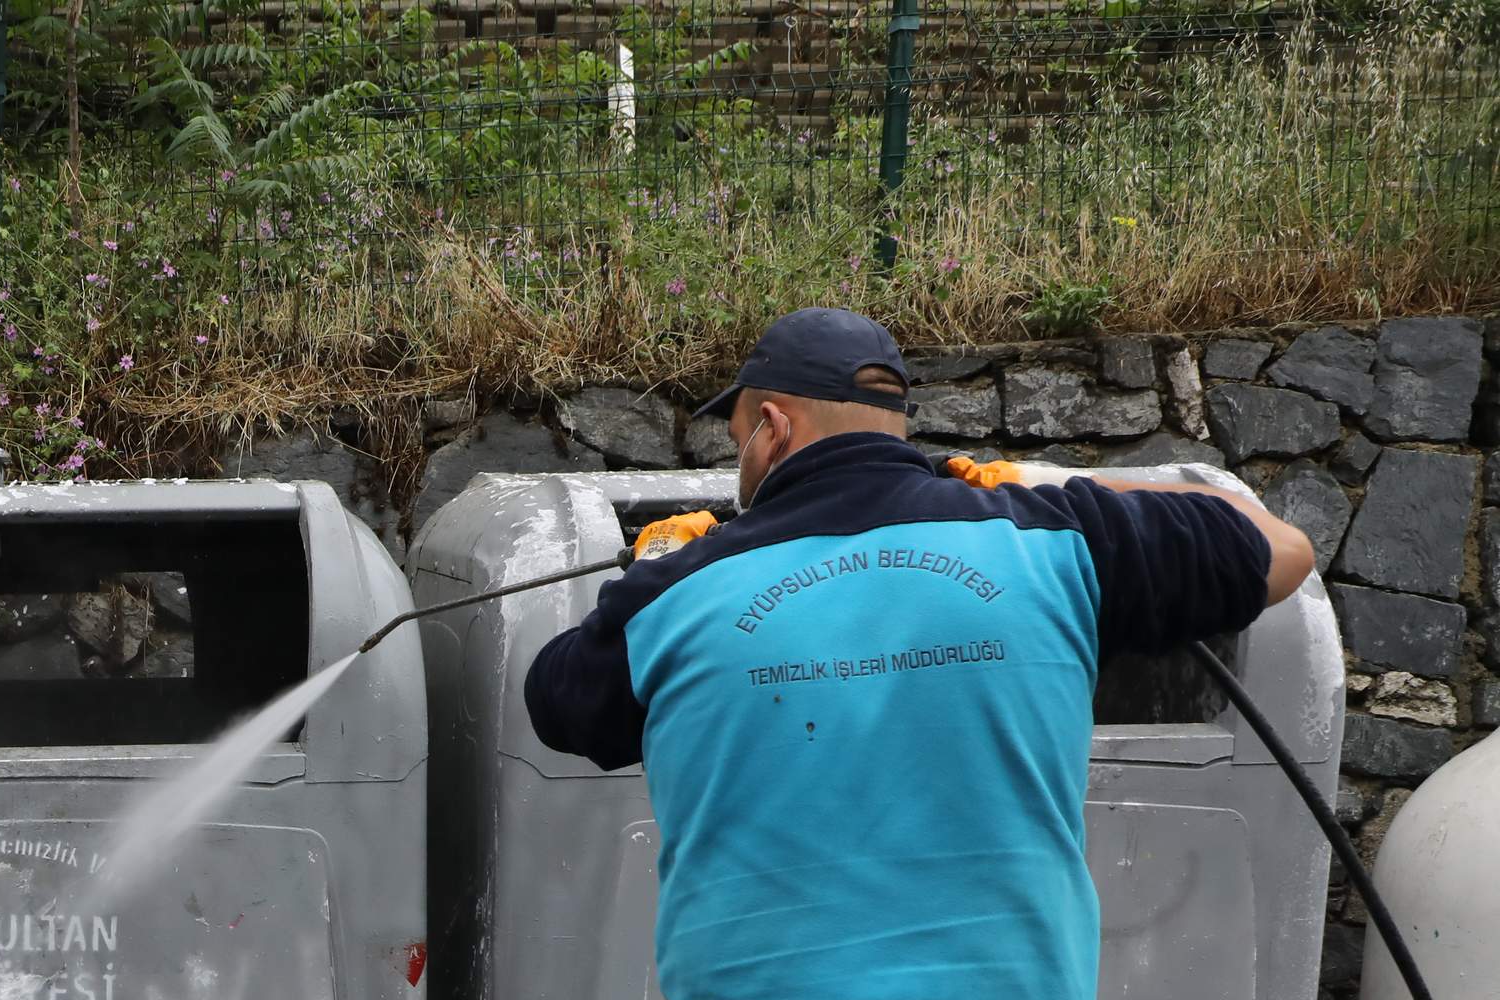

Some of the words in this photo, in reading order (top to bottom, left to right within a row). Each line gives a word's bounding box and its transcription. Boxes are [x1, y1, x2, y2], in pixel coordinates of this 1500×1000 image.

[734, 551, 869, 635] EYÜPSULTAN
[877, 549, 1005, 604] BELEDİYESİ
[747, 658, 828, 686] TEMİZLİK
[832, 653, 886, 682] İŞLERİ
[891, 638, 1005, 672] MÜDÜRLÜĞÜ
